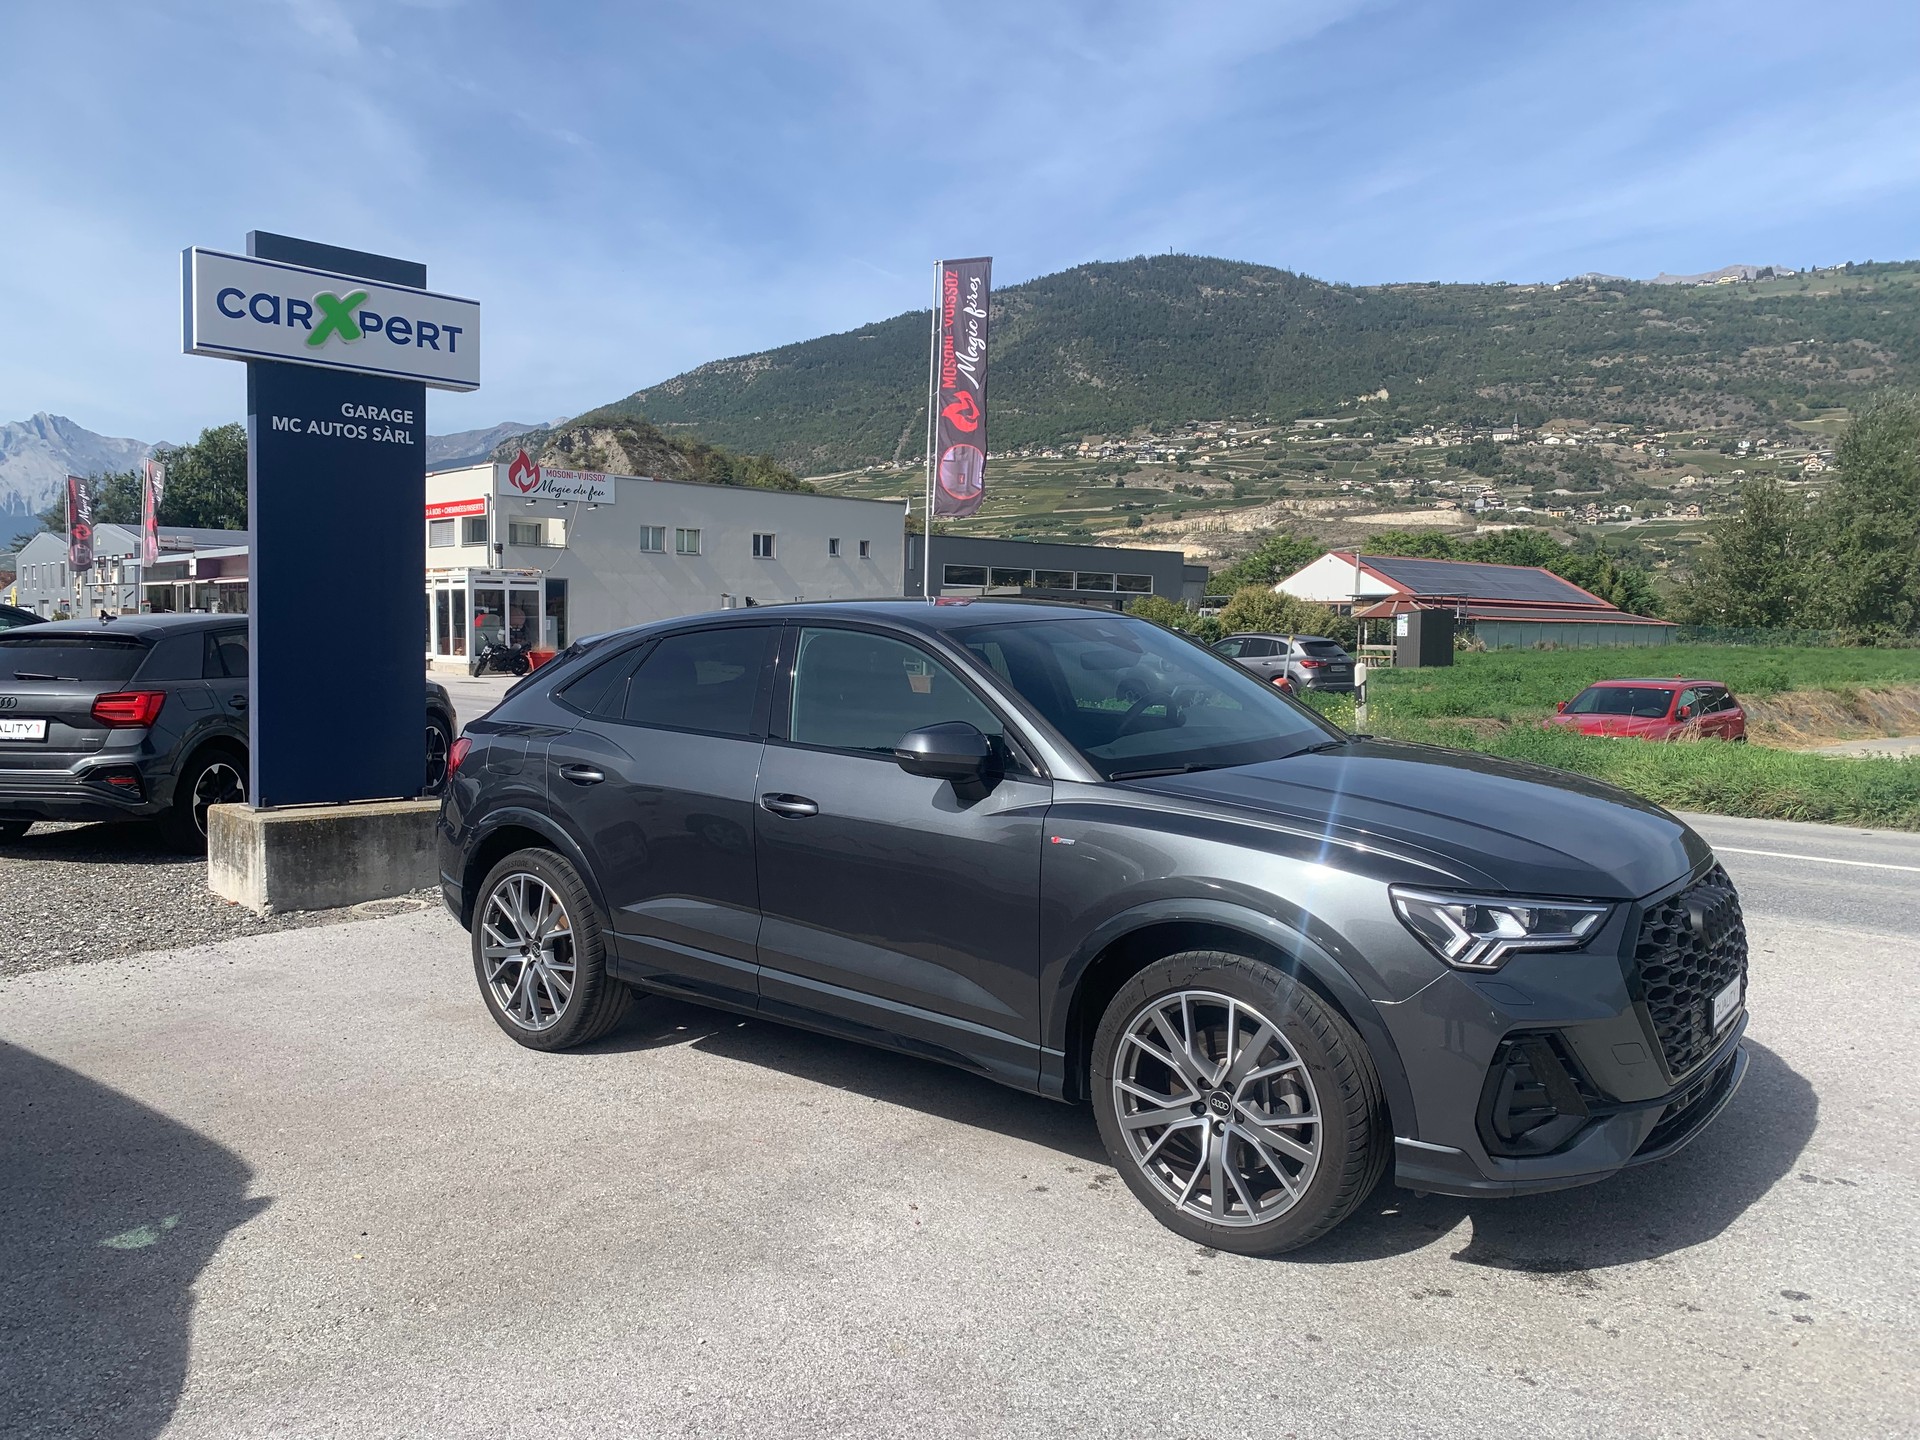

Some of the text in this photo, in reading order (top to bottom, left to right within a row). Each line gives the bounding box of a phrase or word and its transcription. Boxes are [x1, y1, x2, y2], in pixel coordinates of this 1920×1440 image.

[942, 269, 959, 389] MOSONI-VUISSOZ
[955, 276, 988, 390] Magic fires
[341, 402, 414, 424] GARAGE
[272, 415, 414, 445] MC AUTOS SÀRL
[546, 469, 606, 482] MOSONI-VUISSOZ
[533, 479, 605, 501] Magie du feu
